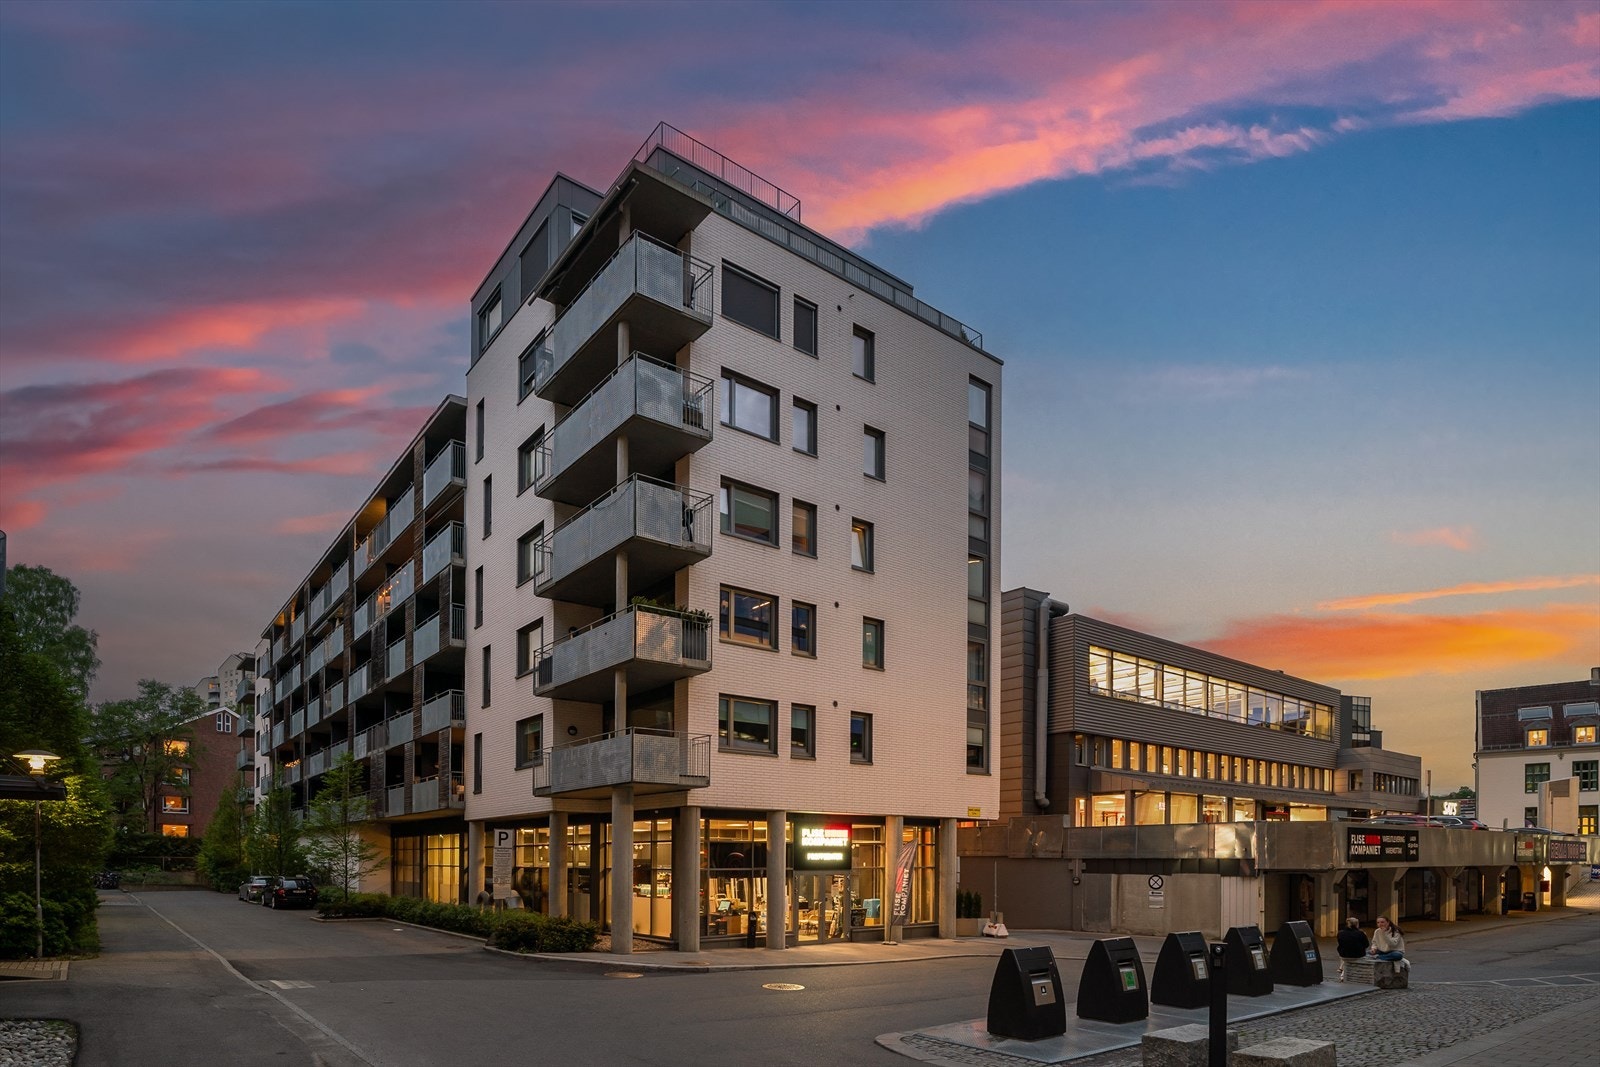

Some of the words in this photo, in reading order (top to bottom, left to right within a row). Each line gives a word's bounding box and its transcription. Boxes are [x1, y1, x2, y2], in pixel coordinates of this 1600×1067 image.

[498, 831, 509, 846] P
[1351, 834, 1366, 844] FLISE
[1350, 845, 1381, 855] KOMPANIET
[1550, 842, 1567, 859] REMA
[900, 868, 910, 916] KOMPANIET
[893, 893, 902, 916] FLISE
